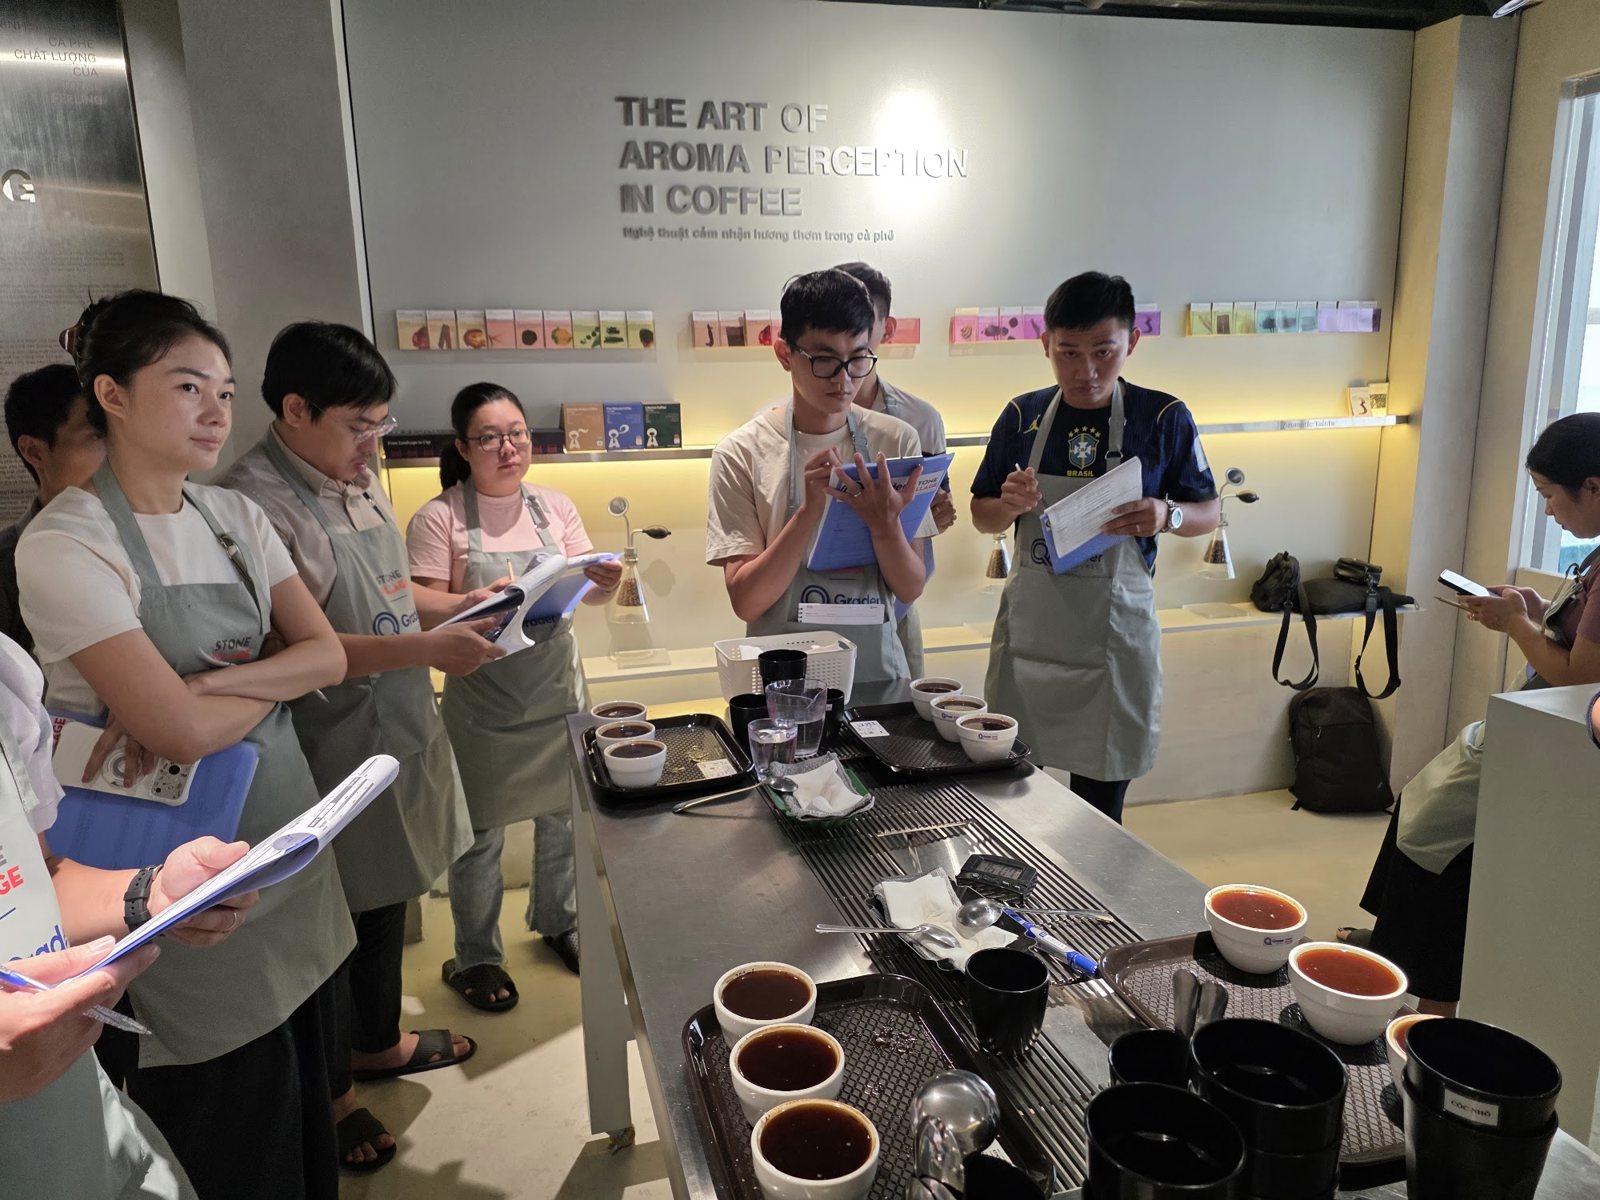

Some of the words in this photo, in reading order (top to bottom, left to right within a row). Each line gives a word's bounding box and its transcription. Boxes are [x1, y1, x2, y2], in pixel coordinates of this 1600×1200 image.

[615, 96, 687, 129] THE
[697, 100, 768, 132] ART
[781, 103, 828, 133] OF
[619, 141, 750, 174] AROMA
[764, 145, 969, 178] PERCEPTION
[619, 184, 654, 214] IN
[666, 185, 803, 216] COFFEE
[657, 226, 689, 242] thuật
[692, 225, 718, 239] cảm
[721, 226, 751, 242] nhận
[753, 228, 789, 242] hương
[824, 230, 854, 243] trong
[1066, 469, 1095, 477] BRASIL
[214, 637, 252, 651] STONE
